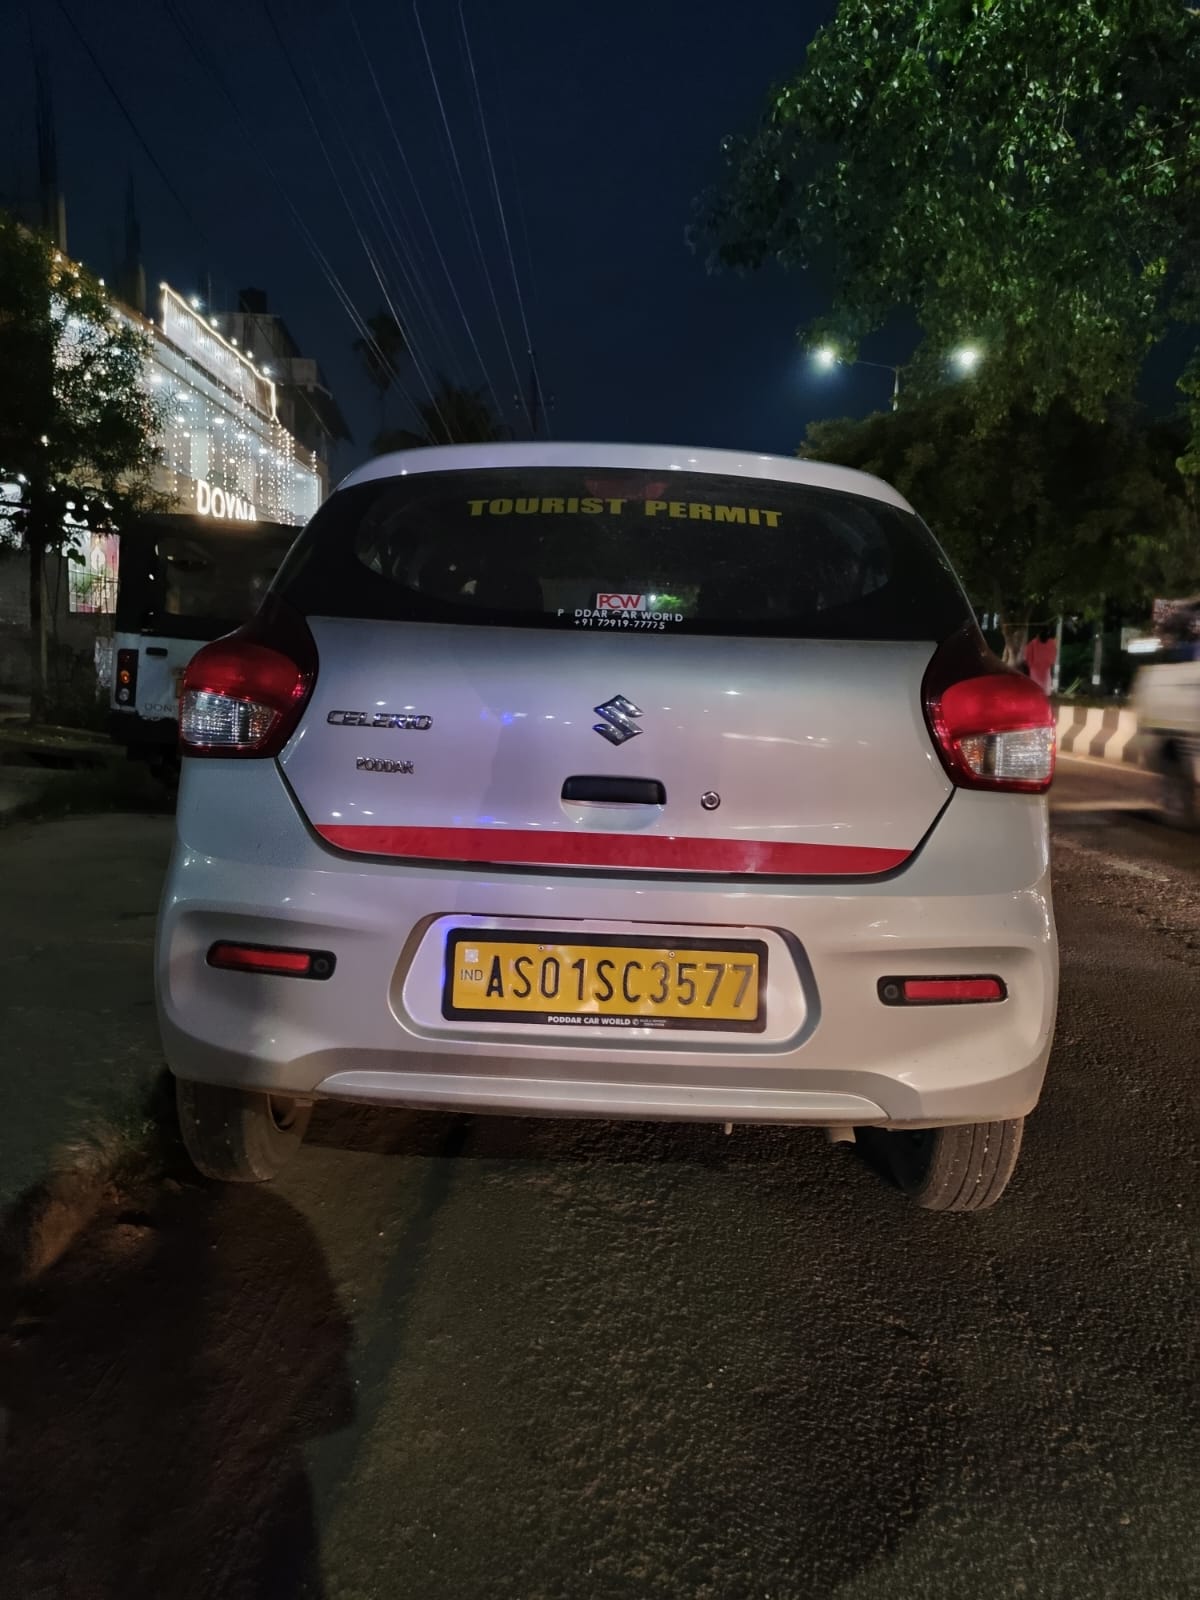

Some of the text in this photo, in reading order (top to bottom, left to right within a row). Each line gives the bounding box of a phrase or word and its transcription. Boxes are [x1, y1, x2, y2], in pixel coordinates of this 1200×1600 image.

[467, 498, 782, 528] TOURIST PERMIT
[599, 594, 641, 609] PCW
[557, 608, 608, 618] PDDAR
[574, 618, 593, 627] +91
[327, 710, 433, 730] CELERIO
[356, 757, 414, 774] PODDAR
[460, 969, 483, 982] IND
[486, 954, 754, 1008] AS01SC3577
[547, 1015, 582, 1024] PODDAR
[584, 1017, 600, 1025] CAR
[601, 1017, 631, 1026] WORLD
